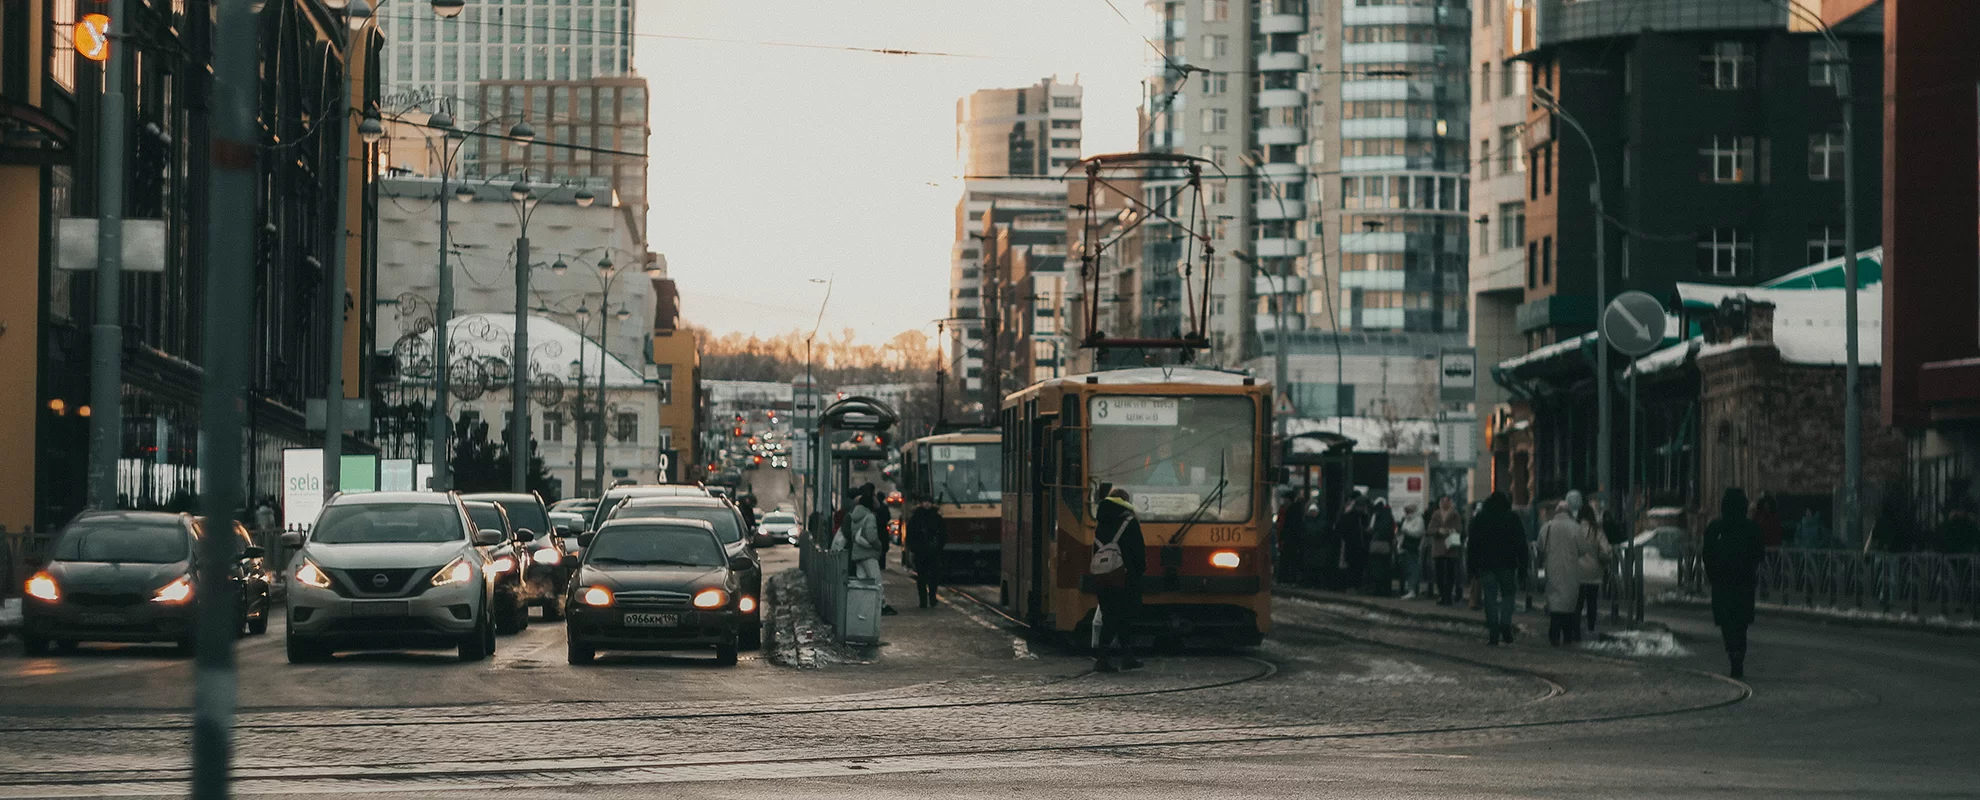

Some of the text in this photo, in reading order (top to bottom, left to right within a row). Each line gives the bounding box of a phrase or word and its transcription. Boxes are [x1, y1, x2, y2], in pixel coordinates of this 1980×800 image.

[1098, 400, 1108, 418] 3
[940, 447, 951, 458] 10
[290, 473, 319, 491] sela
[1210, 527, 1242, 542] 806
